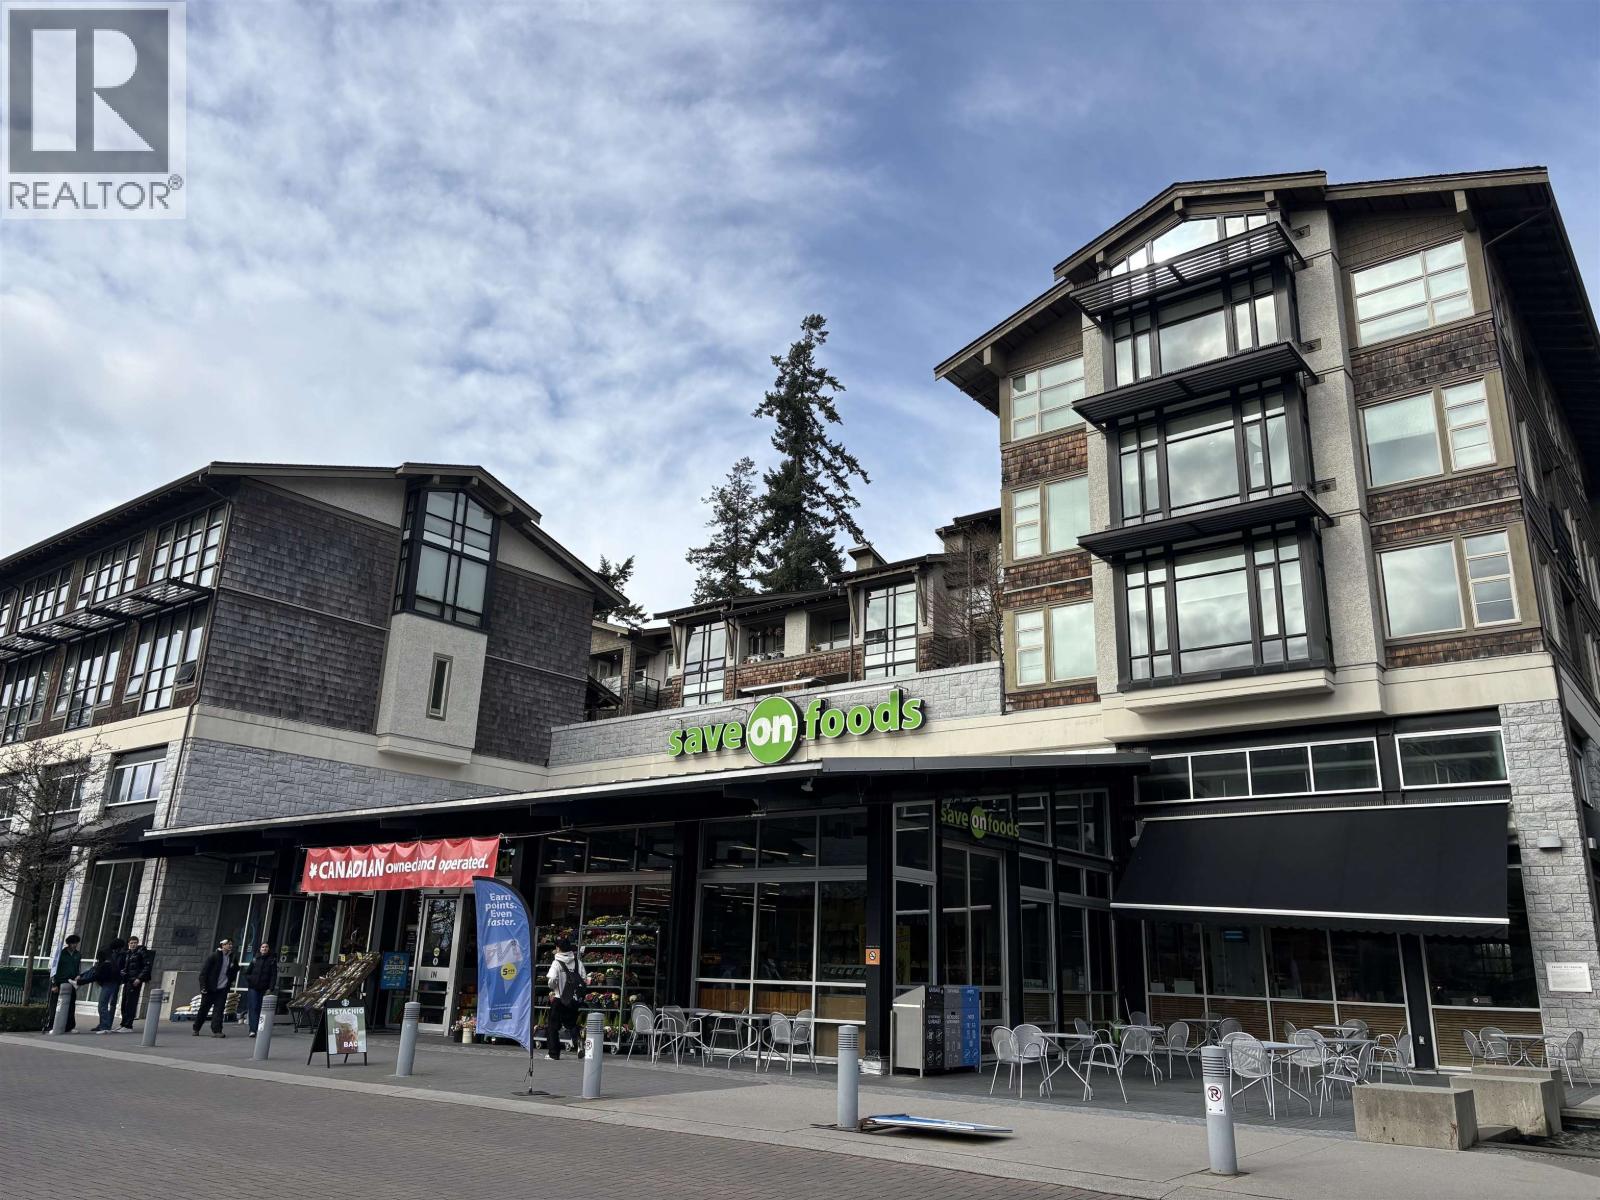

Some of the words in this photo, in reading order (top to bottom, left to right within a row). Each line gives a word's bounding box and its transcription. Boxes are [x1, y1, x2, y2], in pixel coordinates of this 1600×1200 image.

[667, 721, 743, 757] save
[749, 712, 793, 747] on
[803, 688, 924, 741] foods
[941, 807, 969, 827] save
[971, 814, 987, 831] on
[987, 812, 1020, 838] foods
[318, 858, 384, 879] CANADIAN
[438, 853, 489, 876] operated.
[489, 892, 512, 901] Earn
[485, 900, 518, 912] points.
[490, 909, 512, 918] Even
[487, 917, 516, 926] faster.
[430, 970, 438, 979] IN
[327, 1007, 365, 1016] PISTACHIO
[332, 1027, 340, 1035] IS
